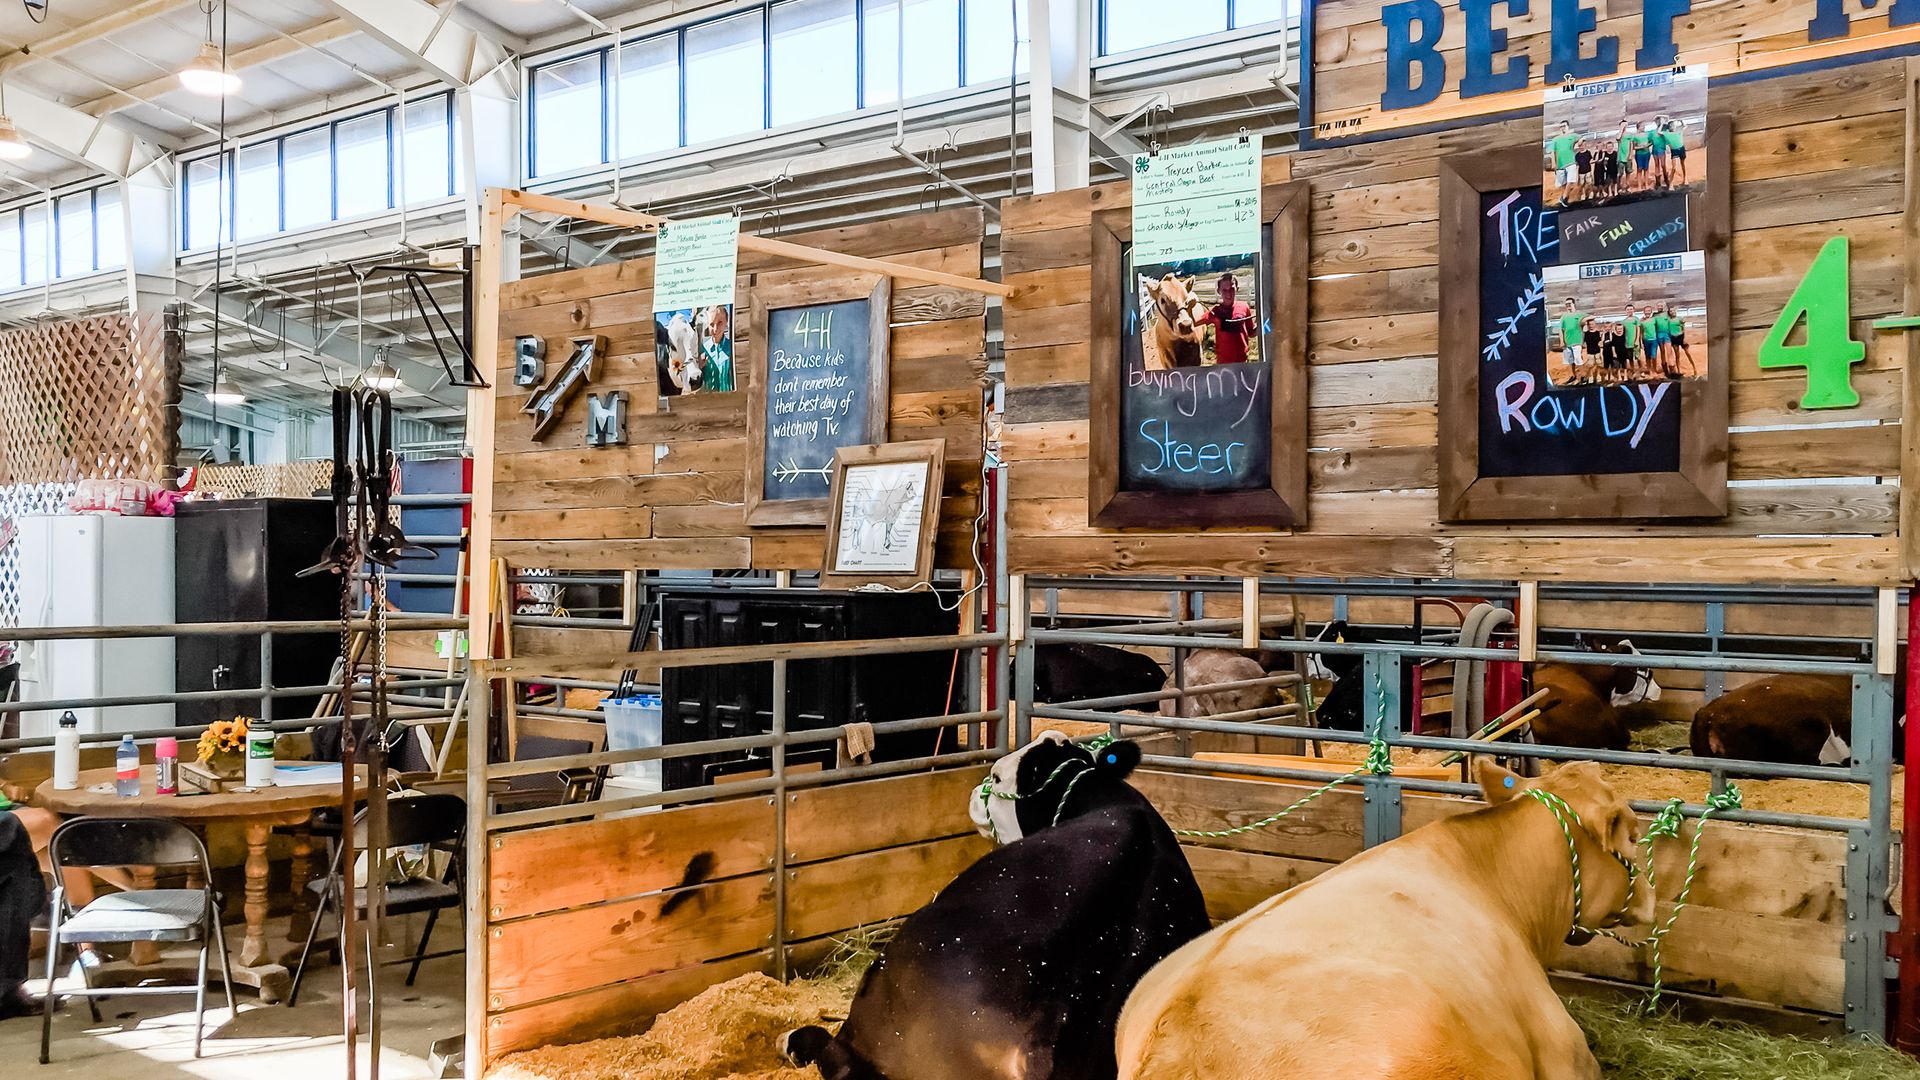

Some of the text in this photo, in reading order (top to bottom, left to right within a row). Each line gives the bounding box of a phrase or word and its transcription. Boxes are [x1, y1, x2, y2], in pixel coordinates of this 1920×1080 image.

[1381, 0, 1691, 112] BEEF
[1582, 75, 1668, 96] BEEF MASTERS
[1171, 150, 1194, 160] Market
[1195, 147, 1218, 156] Animal
[1218, 144, 1233, 153] Stall
[1247, 156, 1254, 166] 6
[1198, 173, 1216, 184] Beef
[1234, 209, 1255, 223] 423
[1486, 190, 1560, 263] TRE
[1564, 215, 1603, 241] FAIR
[1599, 219, 1634, 248] FUN
[1628, 216, 1686, 256] FRIENDS
[1585, 258, 1675, 277] BEEF MASTERS
[793, 309, 834, 350] 4-H
[514, 334, 546, 386] B
[773, 349, 845, 372] Because kids
[801, 372, 849, 392] remember
[774, 390, 855, 416] their best day of
[1128, 362, 1262, 429] buying my
[586, 390, 629, 446] M
[772, 416, 819, 442] watching
[1139, 418, 1245, 475] Steer
